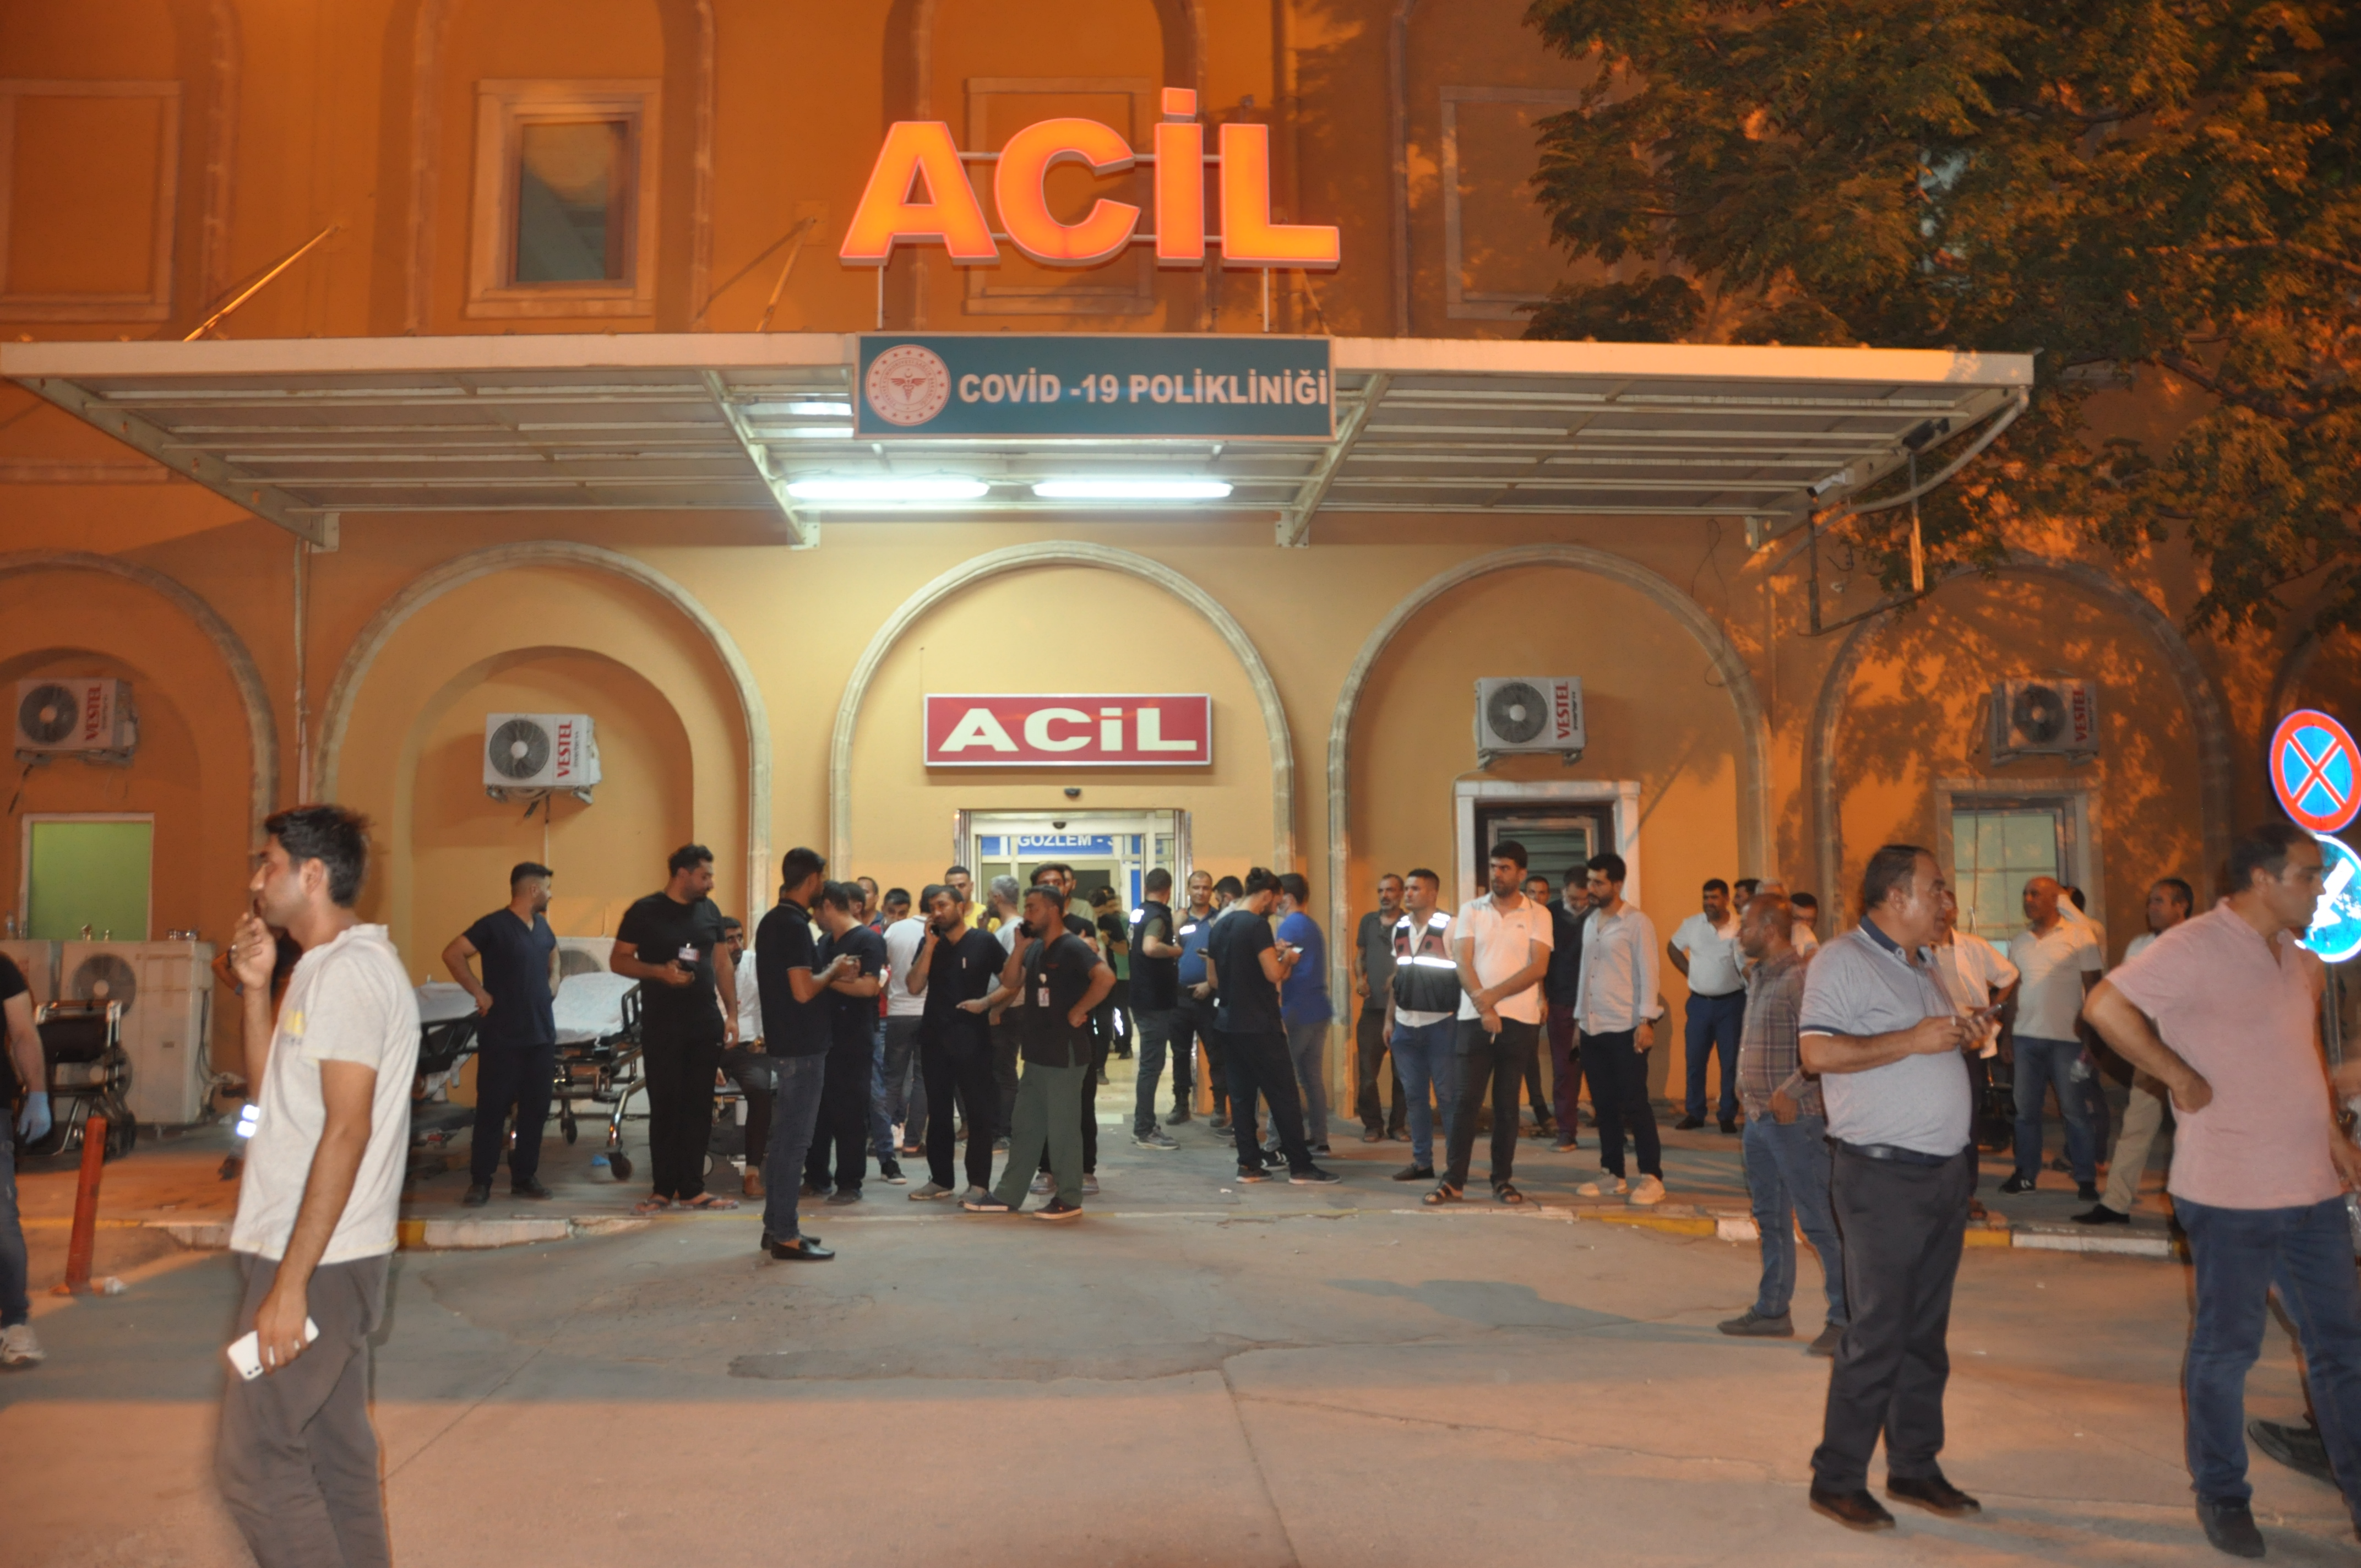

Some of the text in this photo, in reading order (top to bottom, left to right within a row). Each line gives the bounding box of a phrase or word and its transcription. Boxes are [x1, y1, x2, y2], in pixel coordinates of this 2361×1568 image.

[959, 367, 1060, 403] COVİD
[1129, 368, 1328, 405] POLİKLİNİĞİ
[86, 682, 101, 740] VESTEL
[1555, 680, 1570, 739] VESTEL
[2072, 687, 2087, 742] VESTEL
[557, 720, 572, 777] VESTEL
